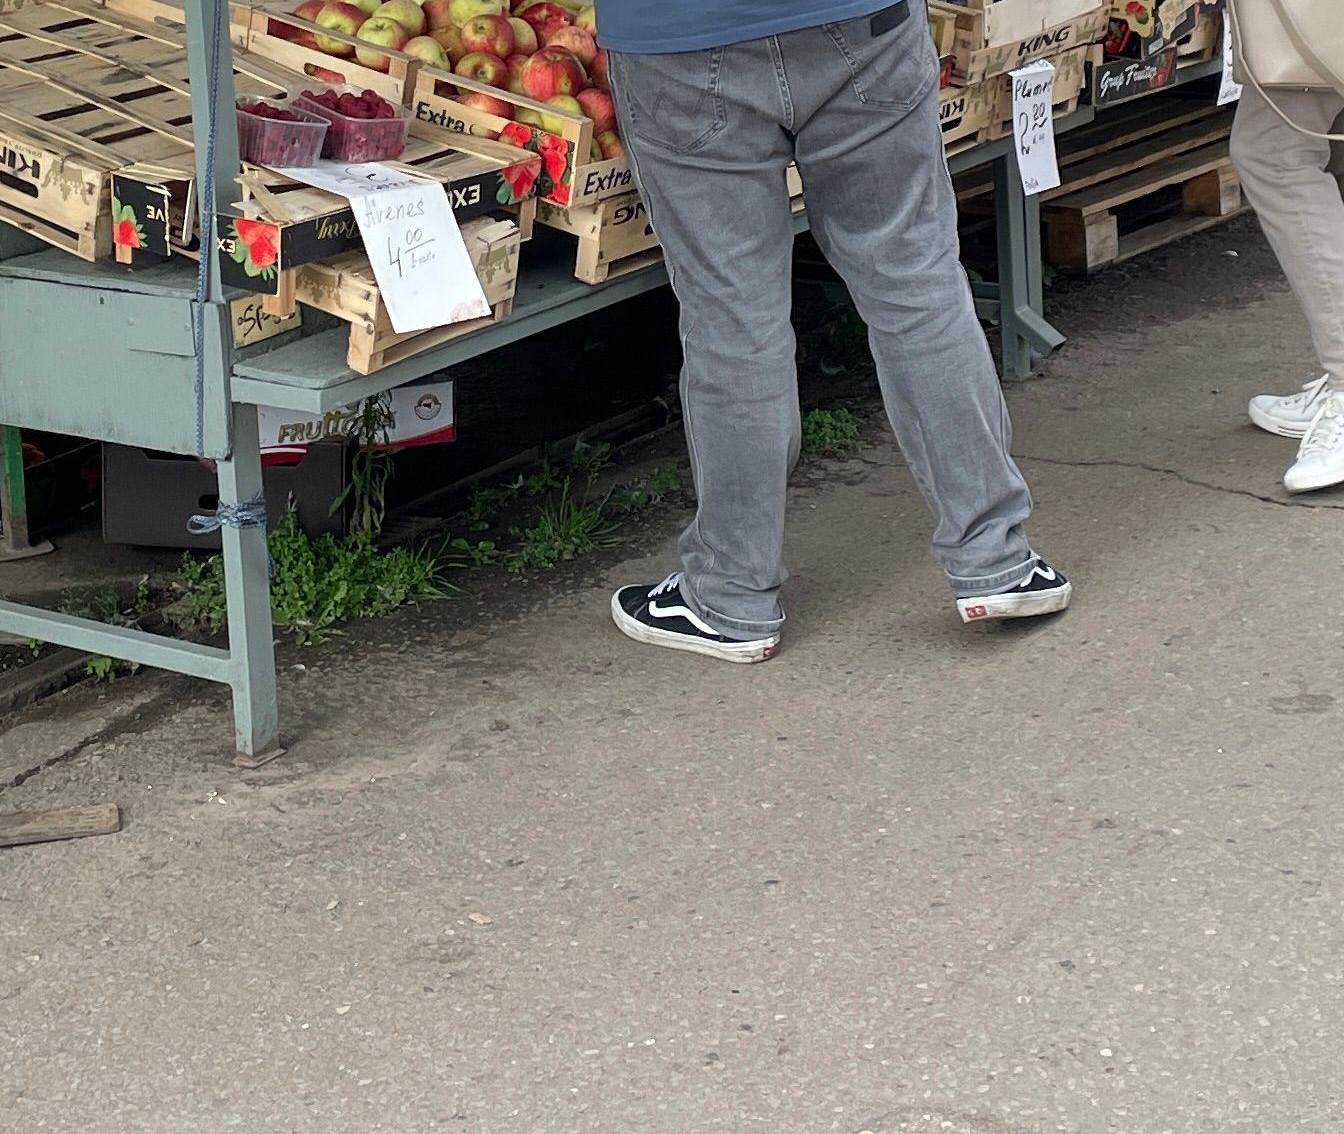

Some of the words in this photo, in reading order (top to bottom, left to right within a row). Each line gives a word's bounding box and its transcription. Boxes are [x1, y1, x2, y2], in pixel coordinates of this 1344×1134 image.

[1018, 27, 1070, 56] KING
[416, 101, 464, 132] Extra
[584, 167, 632, 196] Extra
[406, 228, 422, 245] 00
[387, 236, 402, 279] 4
